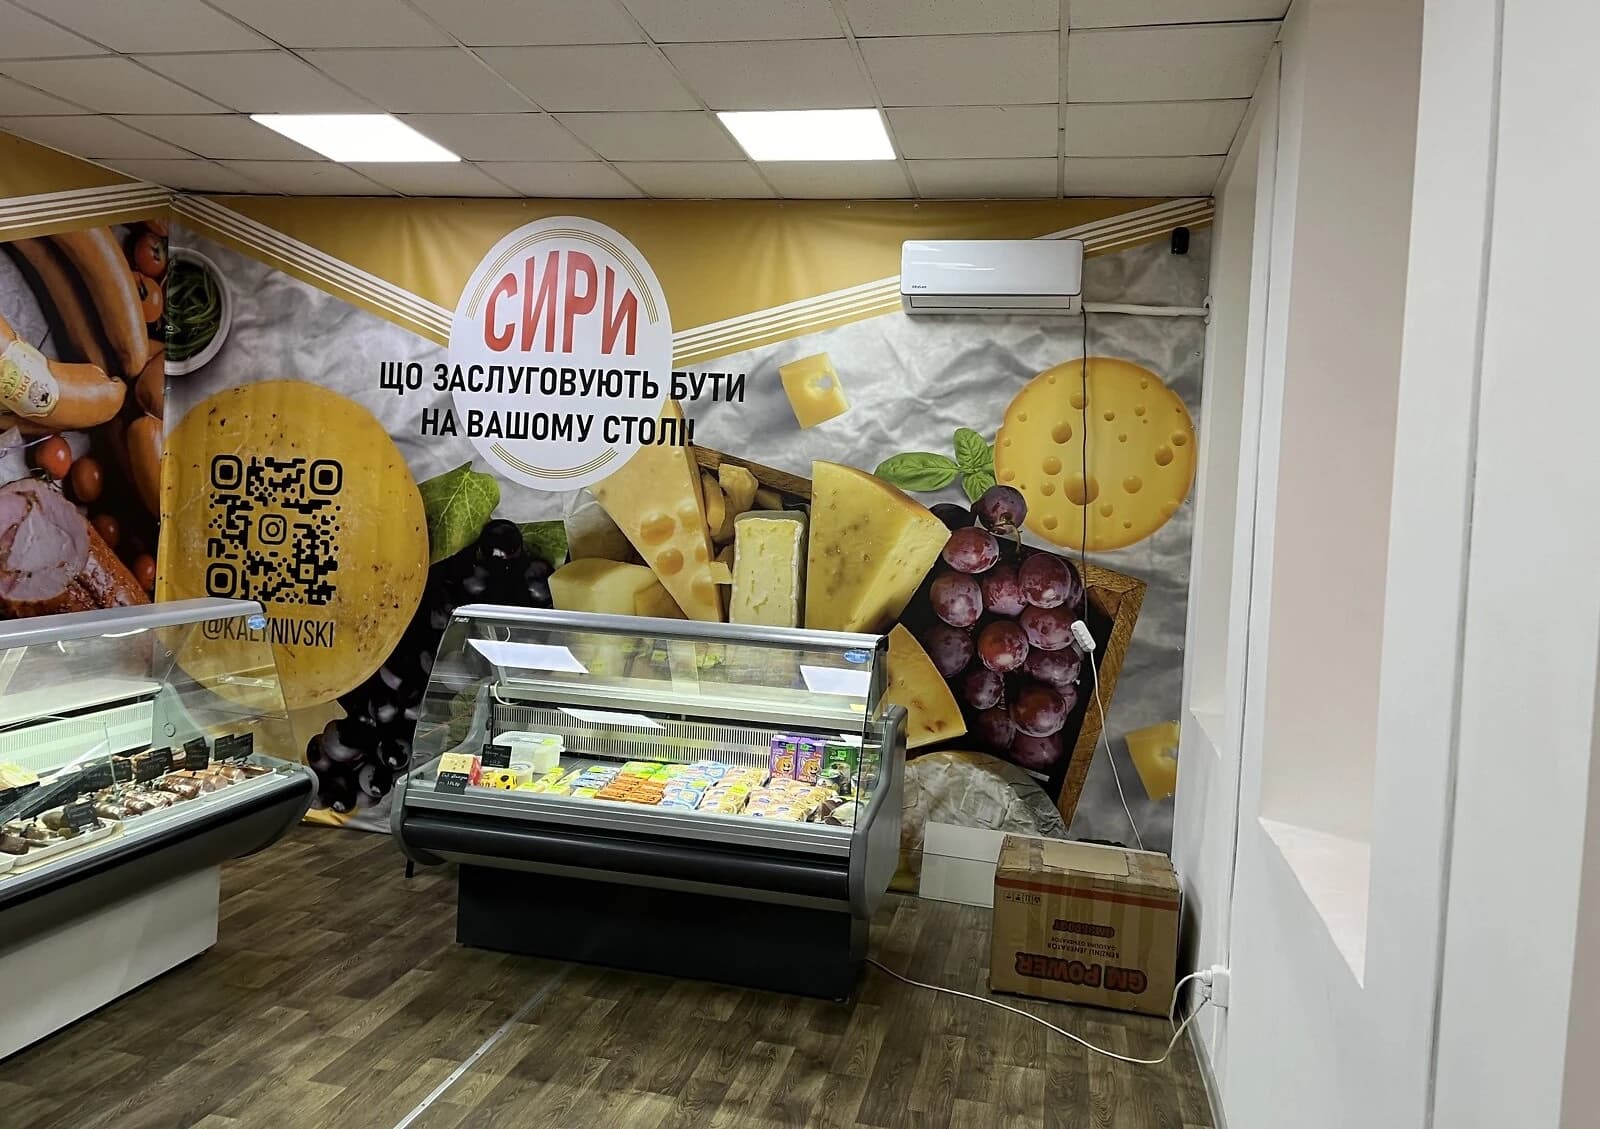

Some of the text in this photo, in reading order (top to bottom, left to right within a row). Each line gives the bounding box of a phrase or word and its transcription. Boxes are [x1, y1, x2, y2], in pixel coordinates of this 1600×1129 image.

[484, 250, 638, 356] СИРИ
[380, 361, 746, 402] ЩО ЗАСЛУГОВУЮТЬ БУТИ
[421, 407, 695, 447] НА ВАШОМУ СТОЛІ!
[1014, 951, 1148, 995] GM POWER
